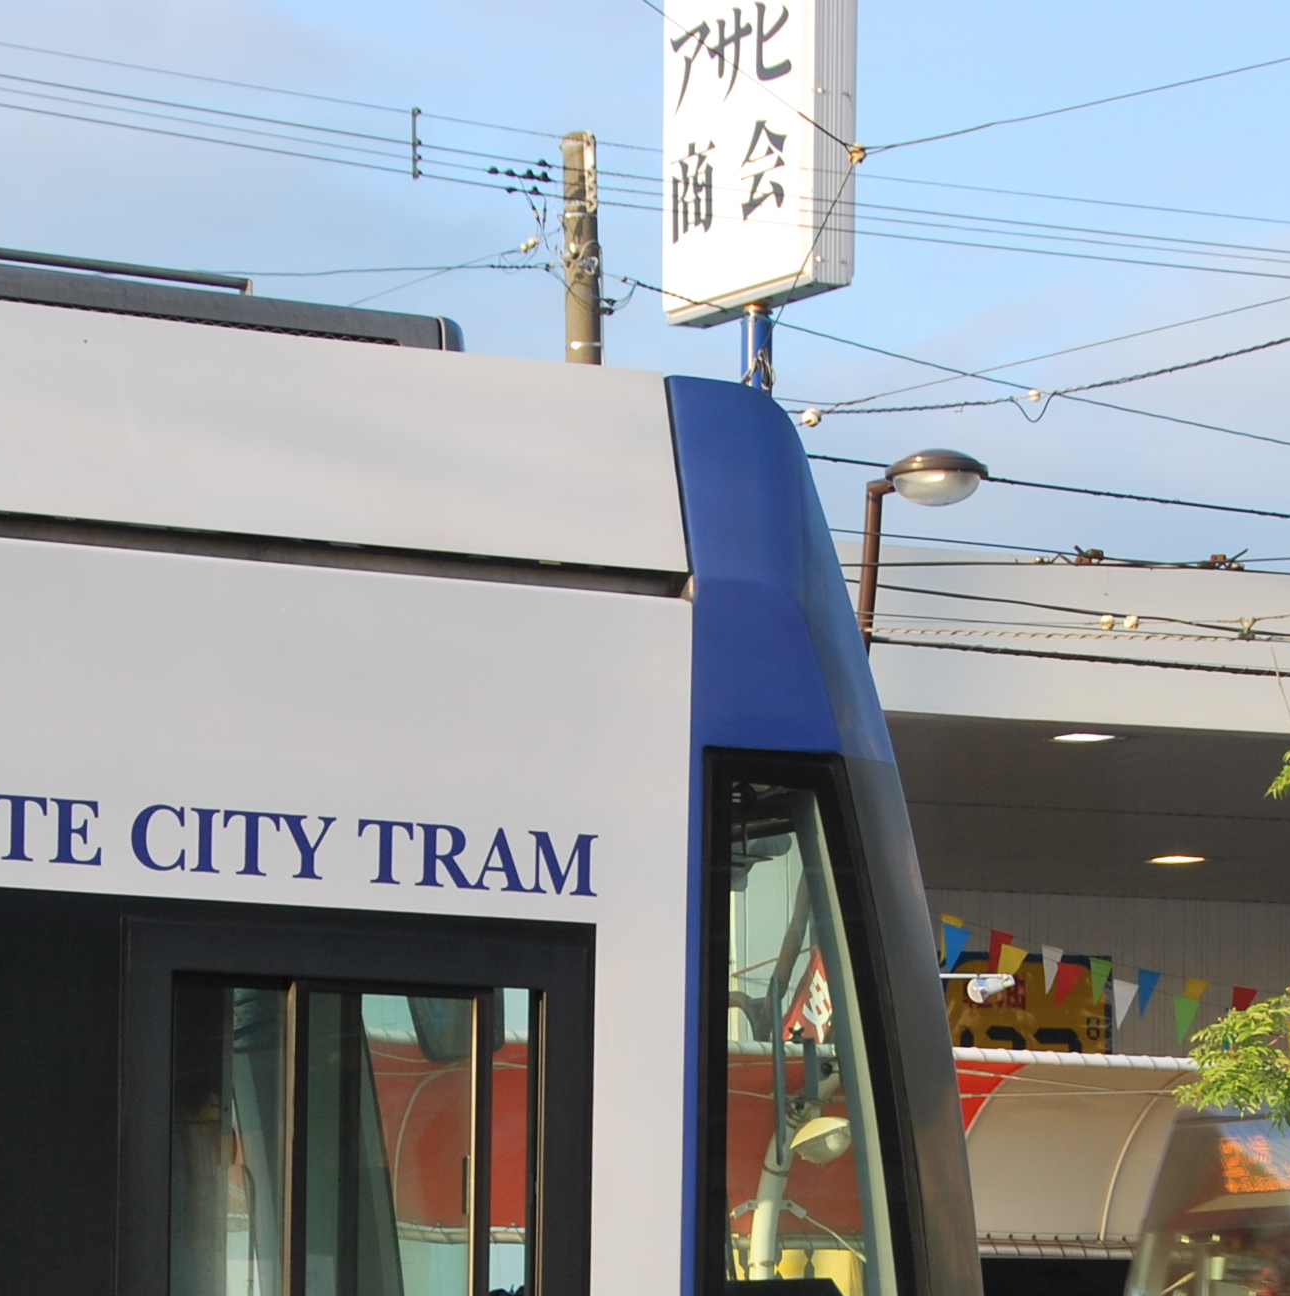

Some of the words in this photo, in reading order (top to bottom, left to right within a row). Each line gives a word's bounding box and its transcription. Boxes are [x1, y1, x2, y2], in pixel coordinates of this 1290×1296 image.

[669, 1, 793, 118] アサヒ
[670, 119, 788, 244] 商会
[130, 803, 337, 880] CITY
[357, 818, 599, 897] TRAM
